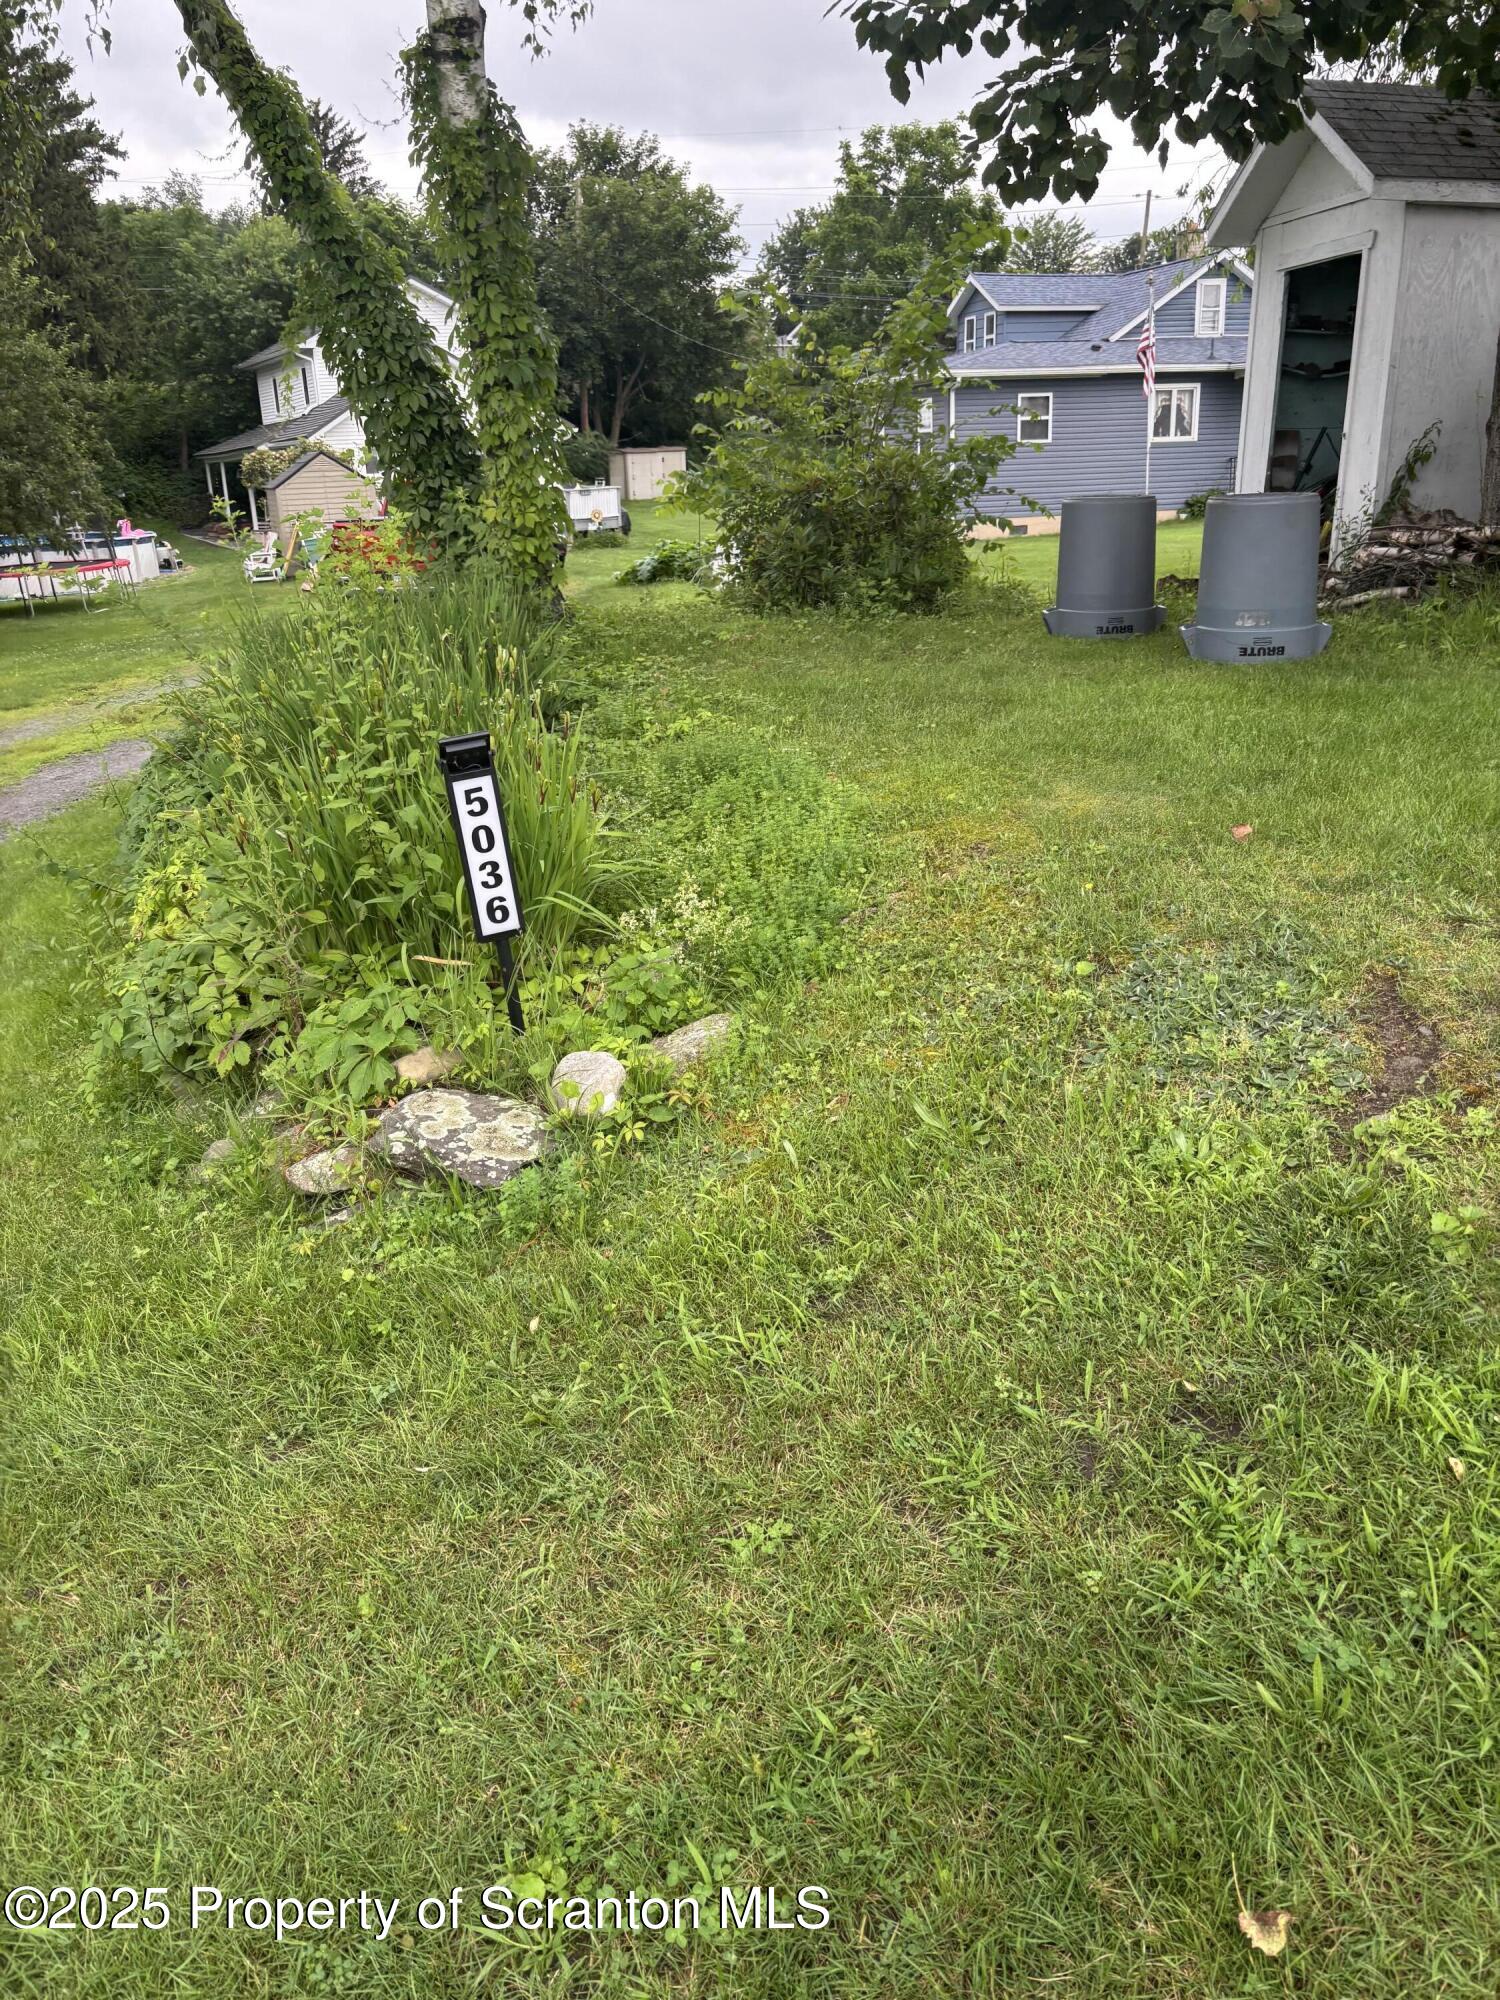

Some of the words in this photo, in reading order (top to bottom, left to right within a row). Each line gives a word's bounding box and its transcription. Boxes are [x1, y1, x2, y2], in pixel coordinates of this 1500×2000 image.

[1096, 624, 1134, 634] BRUTE
[1238, 646, 1285, 656] BRUTE
[464, 786, 510, 924] 5036
